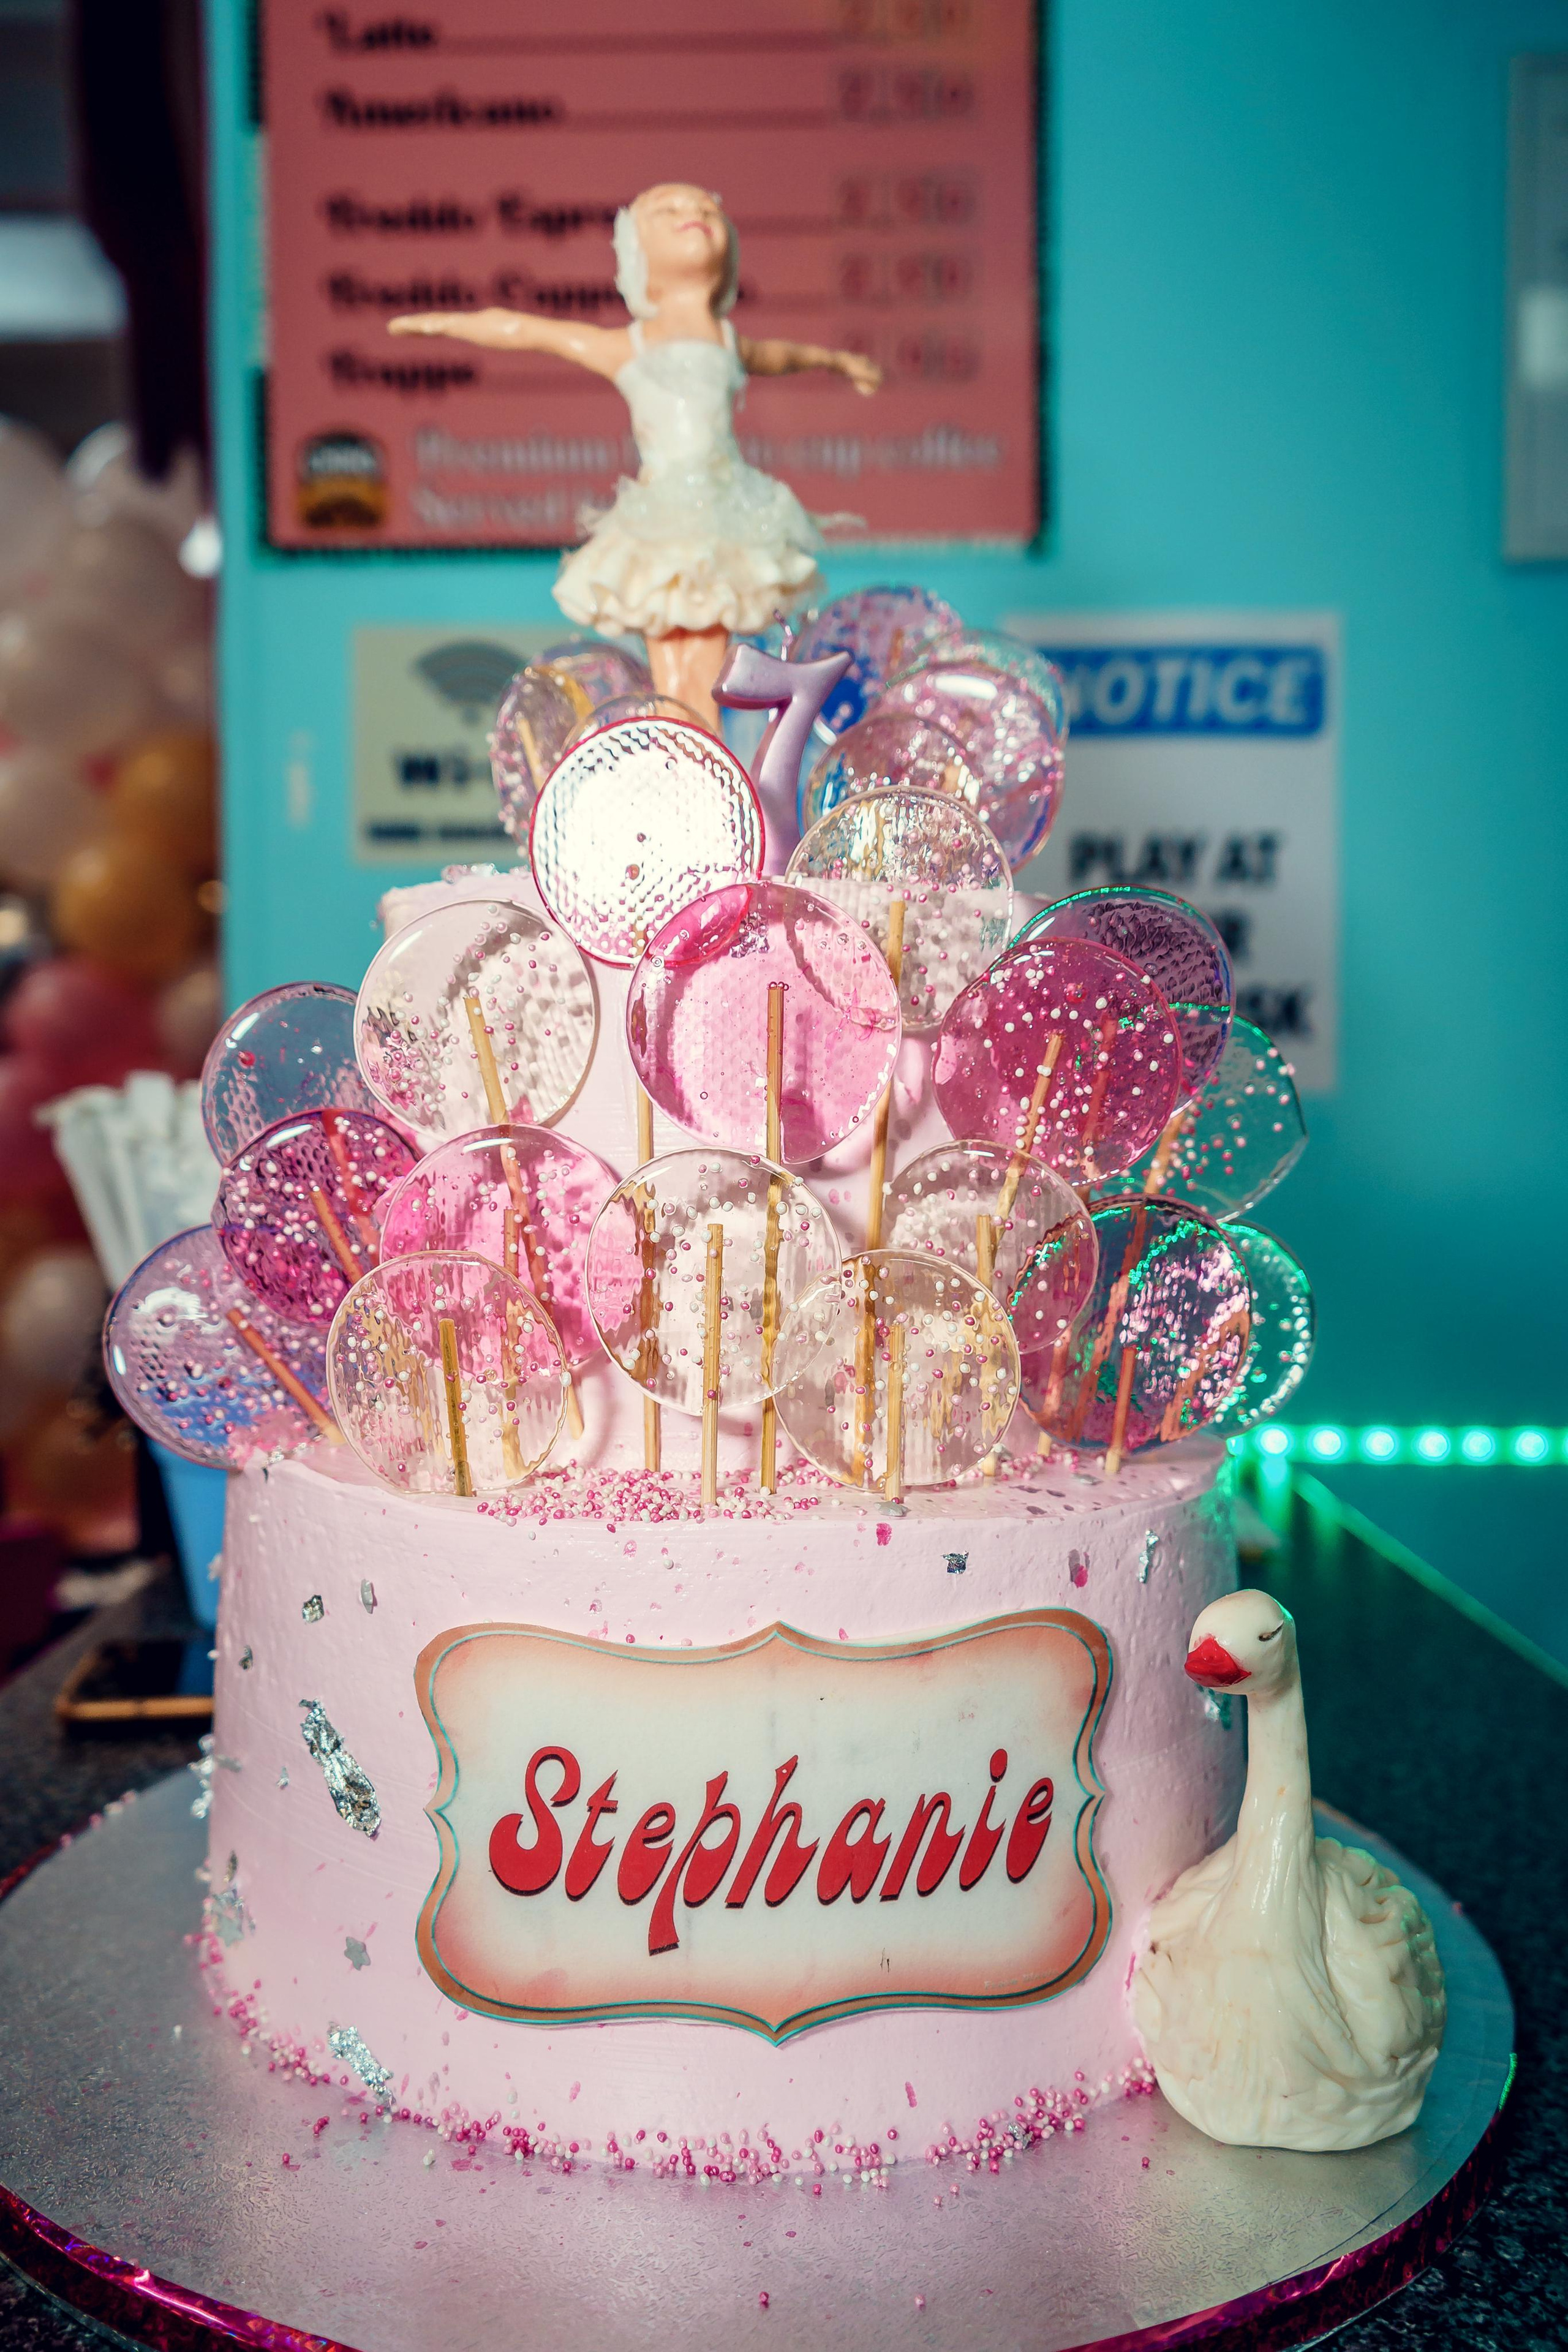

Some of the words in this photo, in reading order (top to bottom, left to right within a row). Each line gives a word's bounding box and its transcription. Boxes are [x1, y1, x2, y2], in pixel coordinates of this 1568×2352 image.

[1067, 830, 1197, 885] PLAY
[1215, 829, 1278, 883] AT
[488, 1745, 1055, 1956] Stephanie
